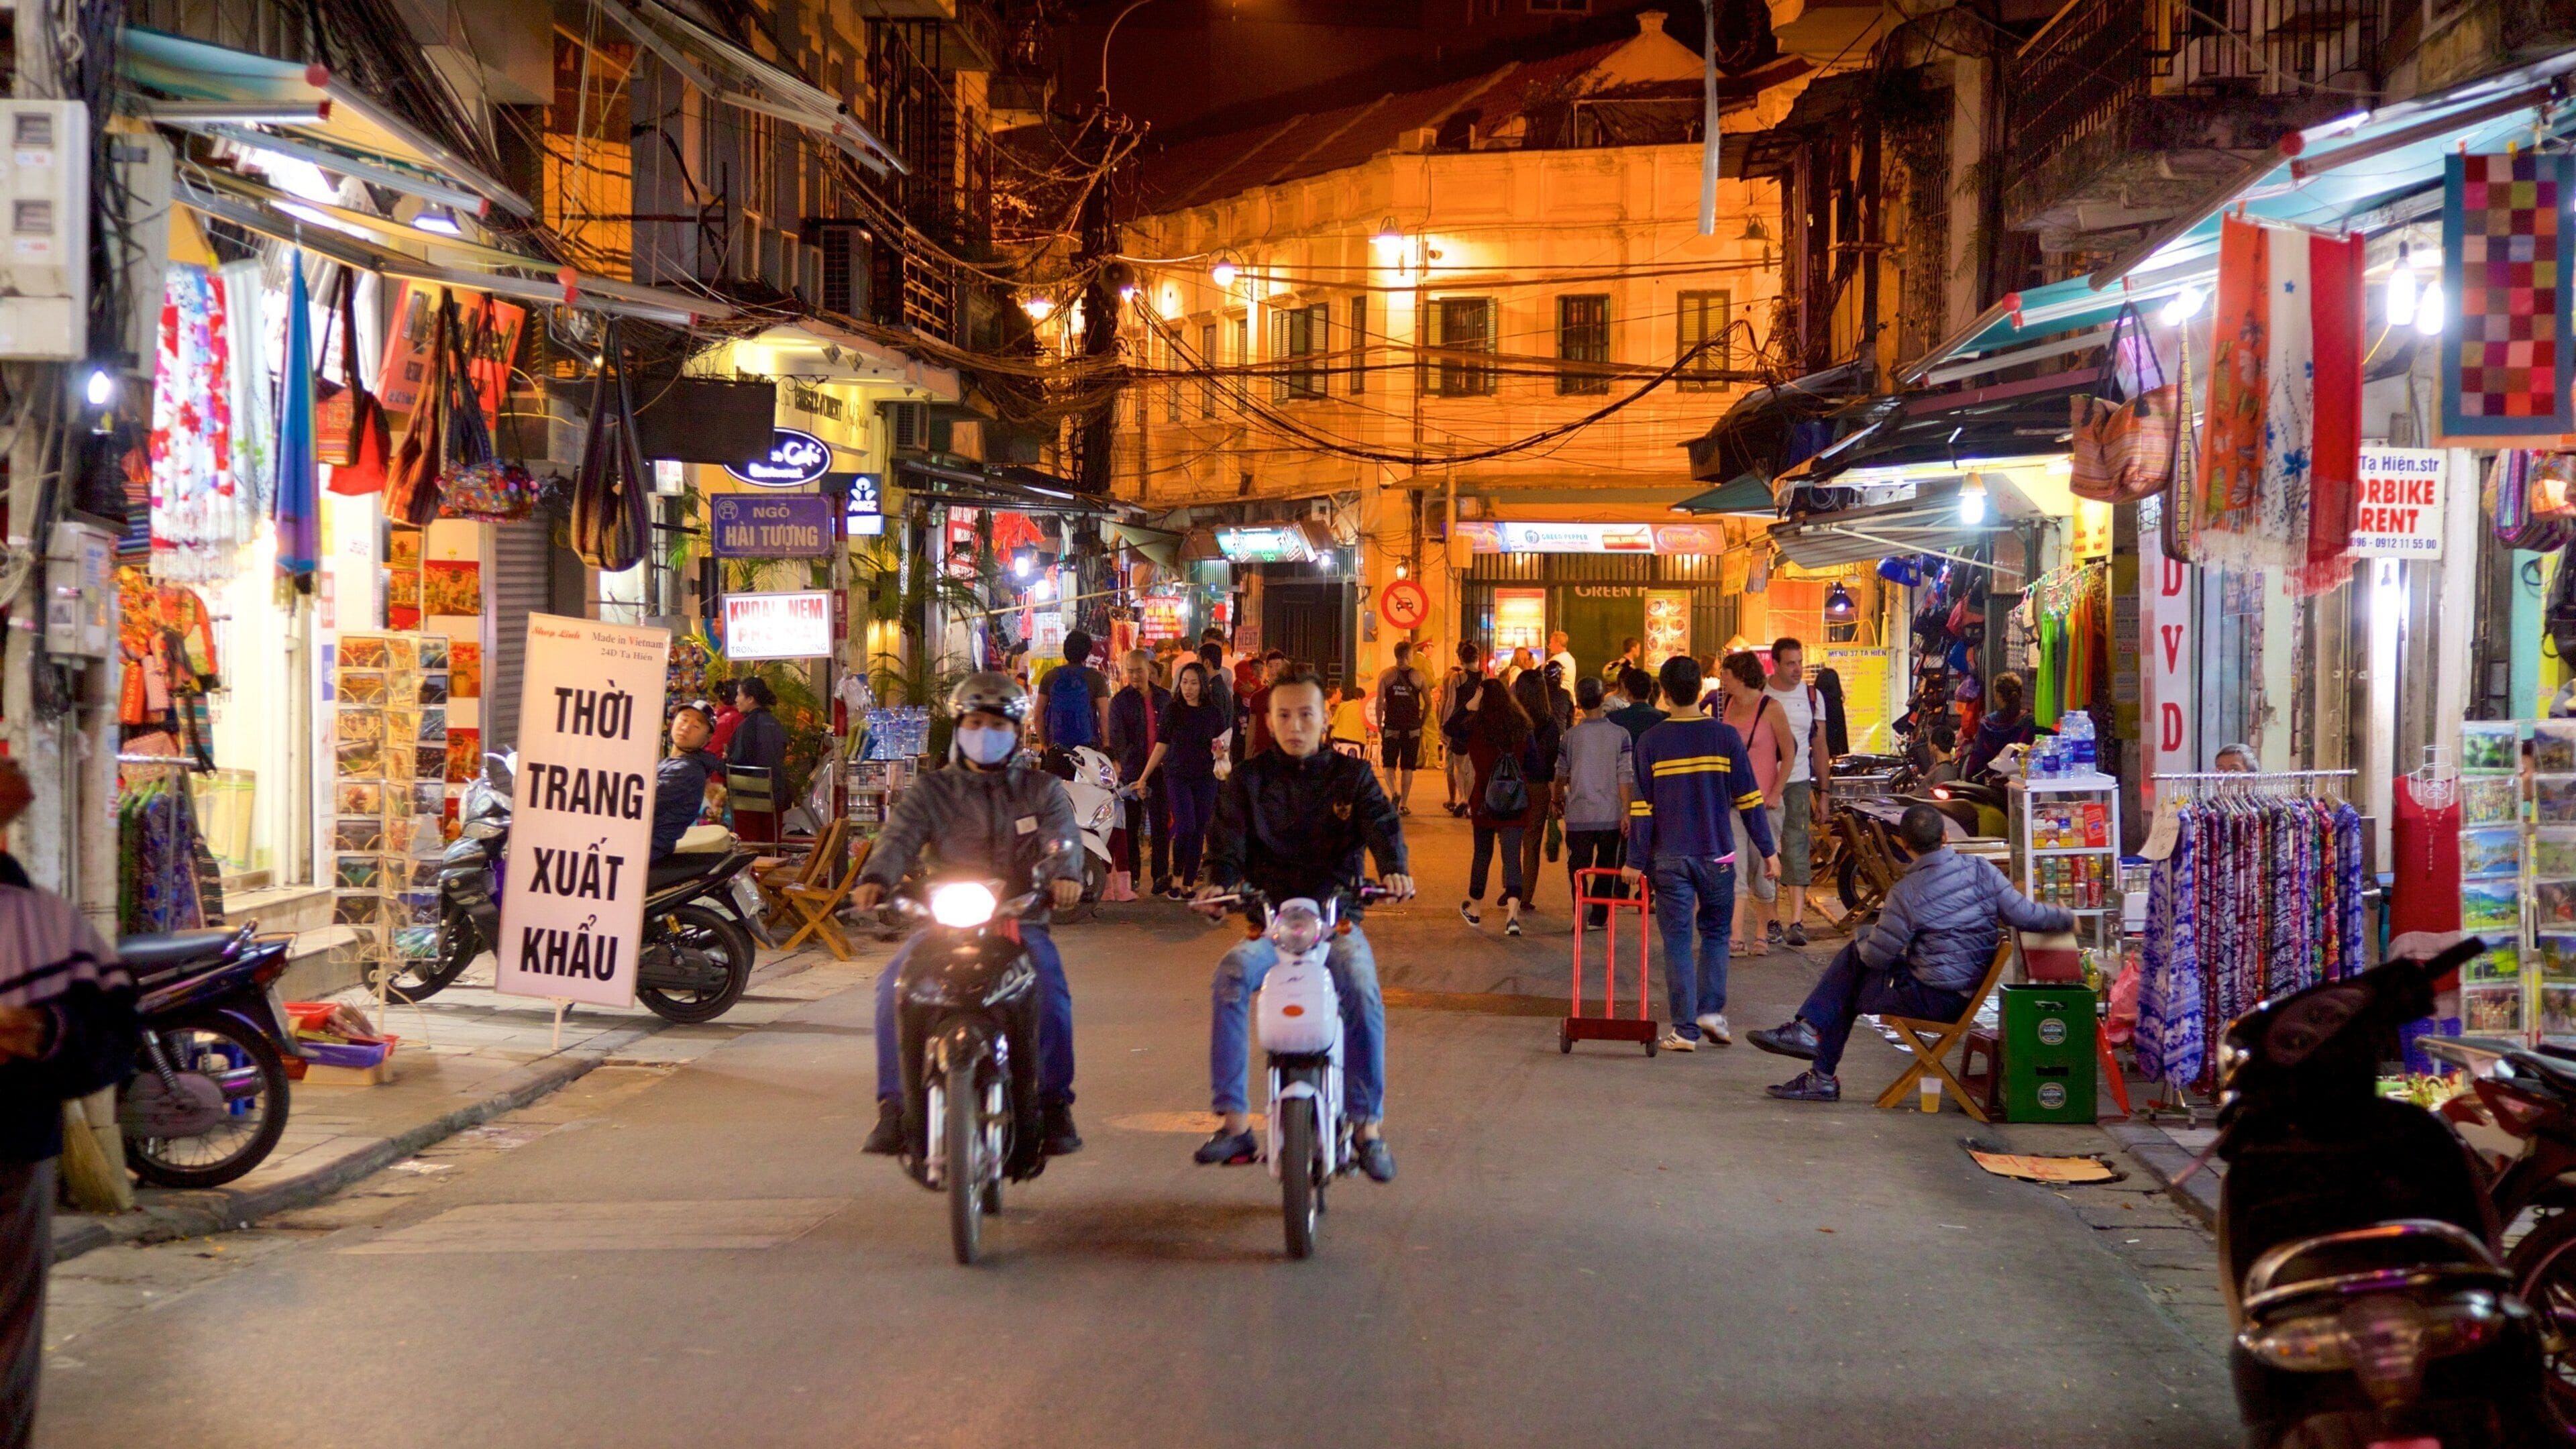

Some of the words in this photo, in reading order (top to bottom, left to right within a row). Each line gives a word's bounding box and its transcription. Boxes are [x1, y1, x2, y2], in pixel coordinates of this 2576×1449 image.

[2361, 455, 2376, 474] Tạ
[753, 503, 790, 518] NGÕ
[2361, 508, 2419, 533] RENT
[725, 521, 755, 547] HÀI
[760, 523, 818, 551] TƯỢNG
[2375, 537, 2397, 548] 0912
[2400, 538, 2409, 548] 11
[2413, 539, 2423, 549] 55
[2426, 539, 2436, 549] 00
[592, 631, 616, 645] Made
[618, 634, 627, 645] in
[629, 635, 664, 649] Vietnam
[600, 647, 618, 658] 24D
[554, 678, 634, 741] THỜI
[527, 762, 645, 821] TRANG
[529, 837, 625, 902] XUẤT
[519, 913, 619, 983] KHẨU
